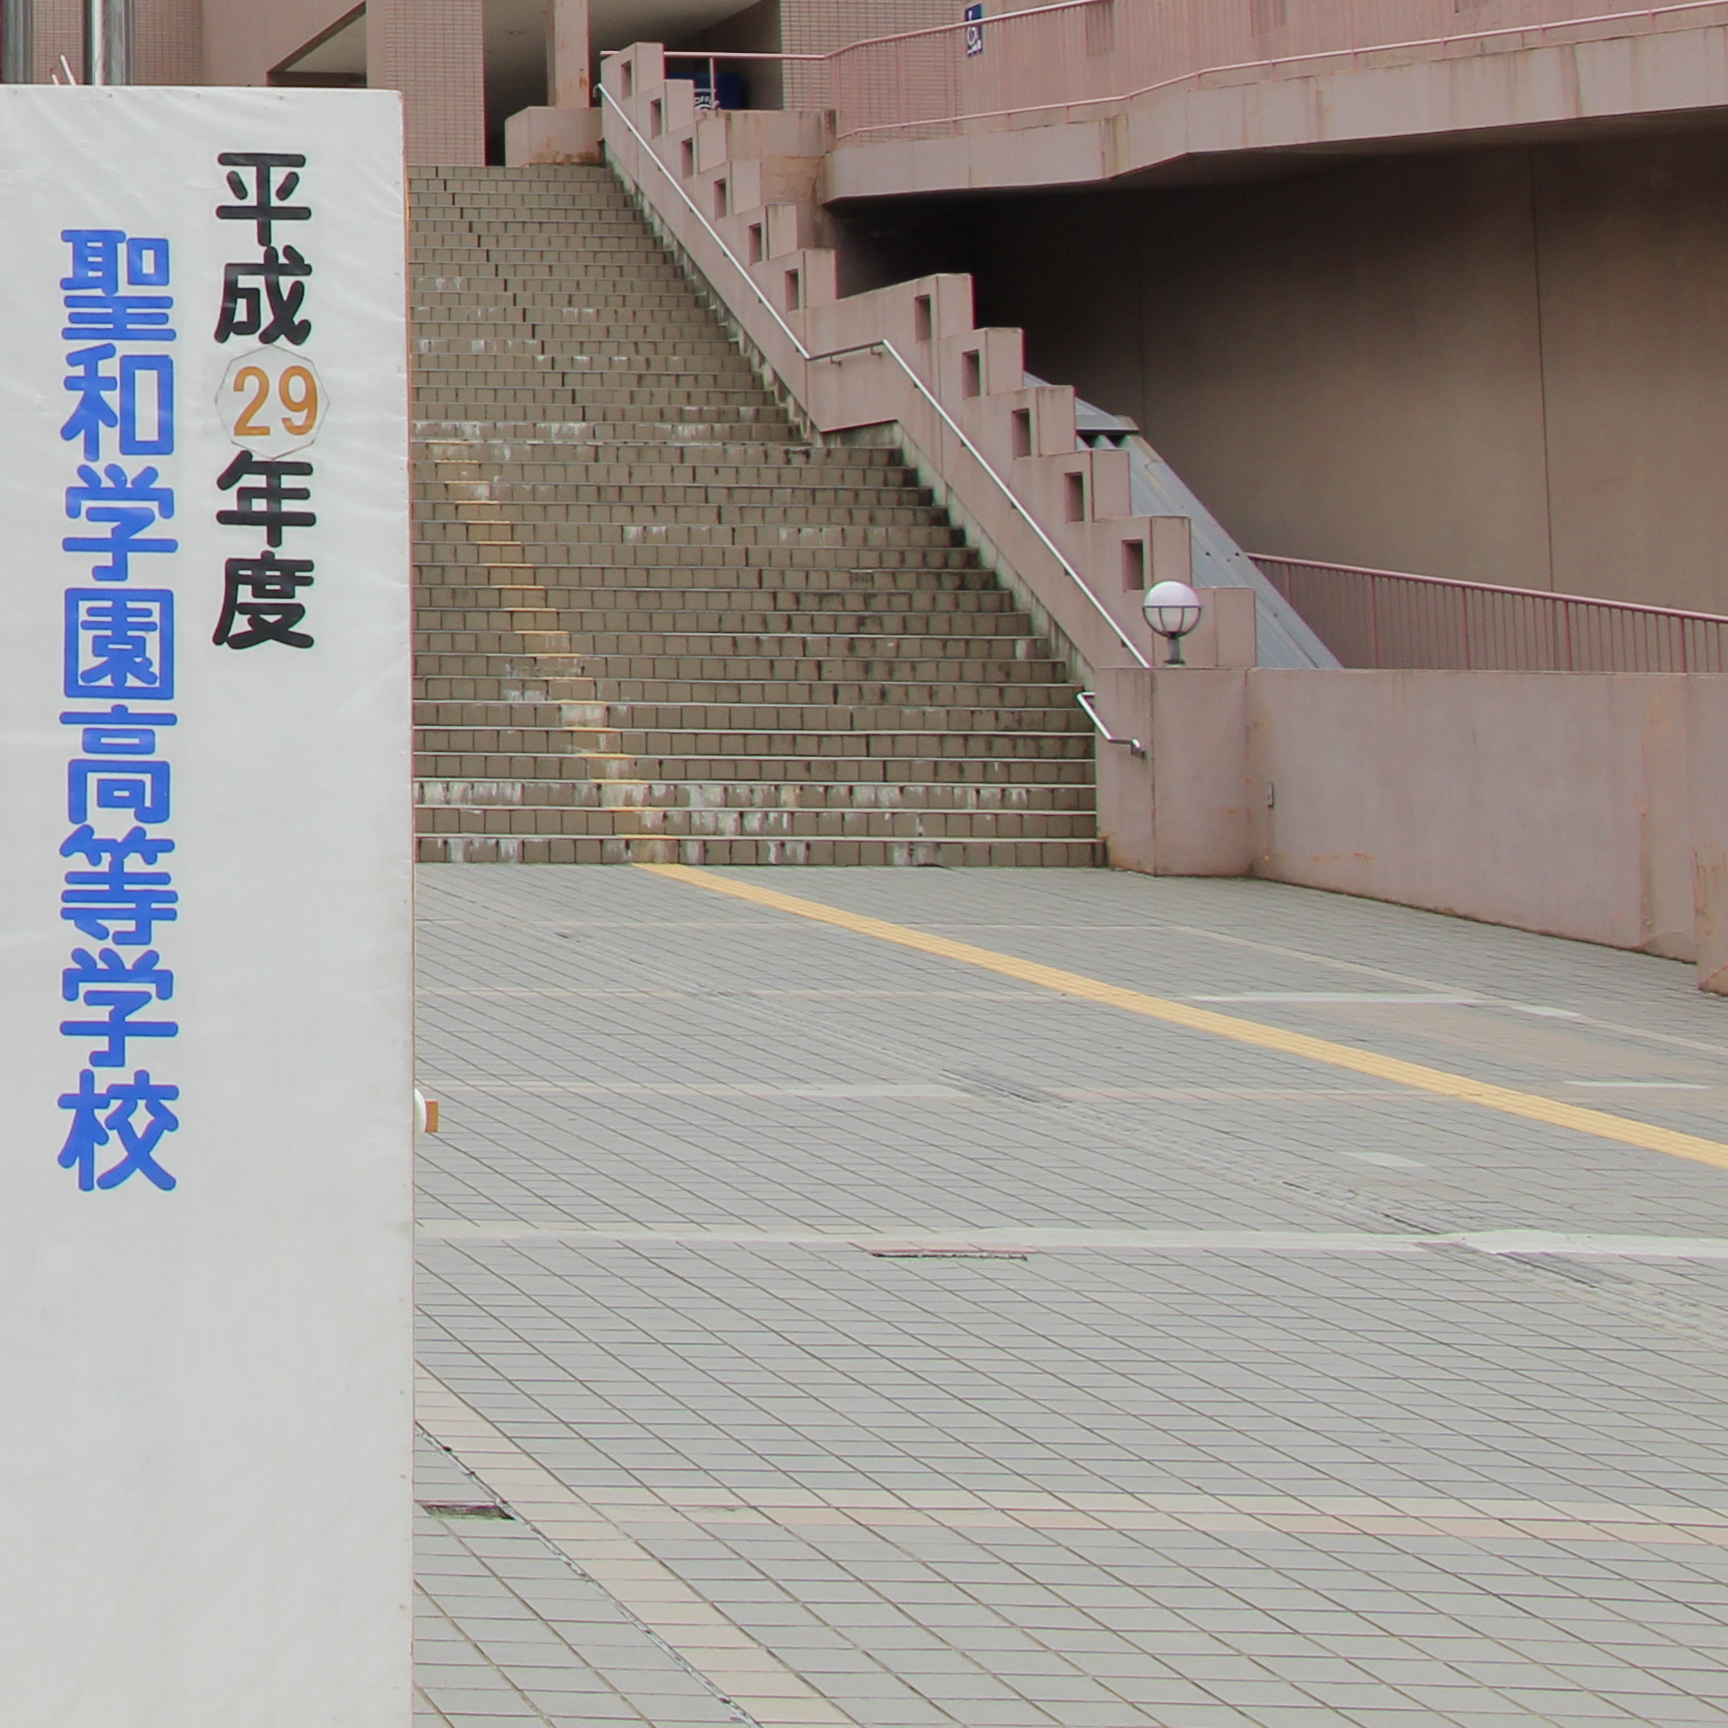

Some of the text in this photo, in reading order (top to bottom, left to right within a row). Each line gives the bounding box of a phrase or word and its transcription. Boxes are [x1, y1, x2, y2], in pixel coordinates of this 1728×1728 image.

[58, 229, 181, 1193] 聖和学園高等学校
[212, 152, 321, 650] 平成29年度
